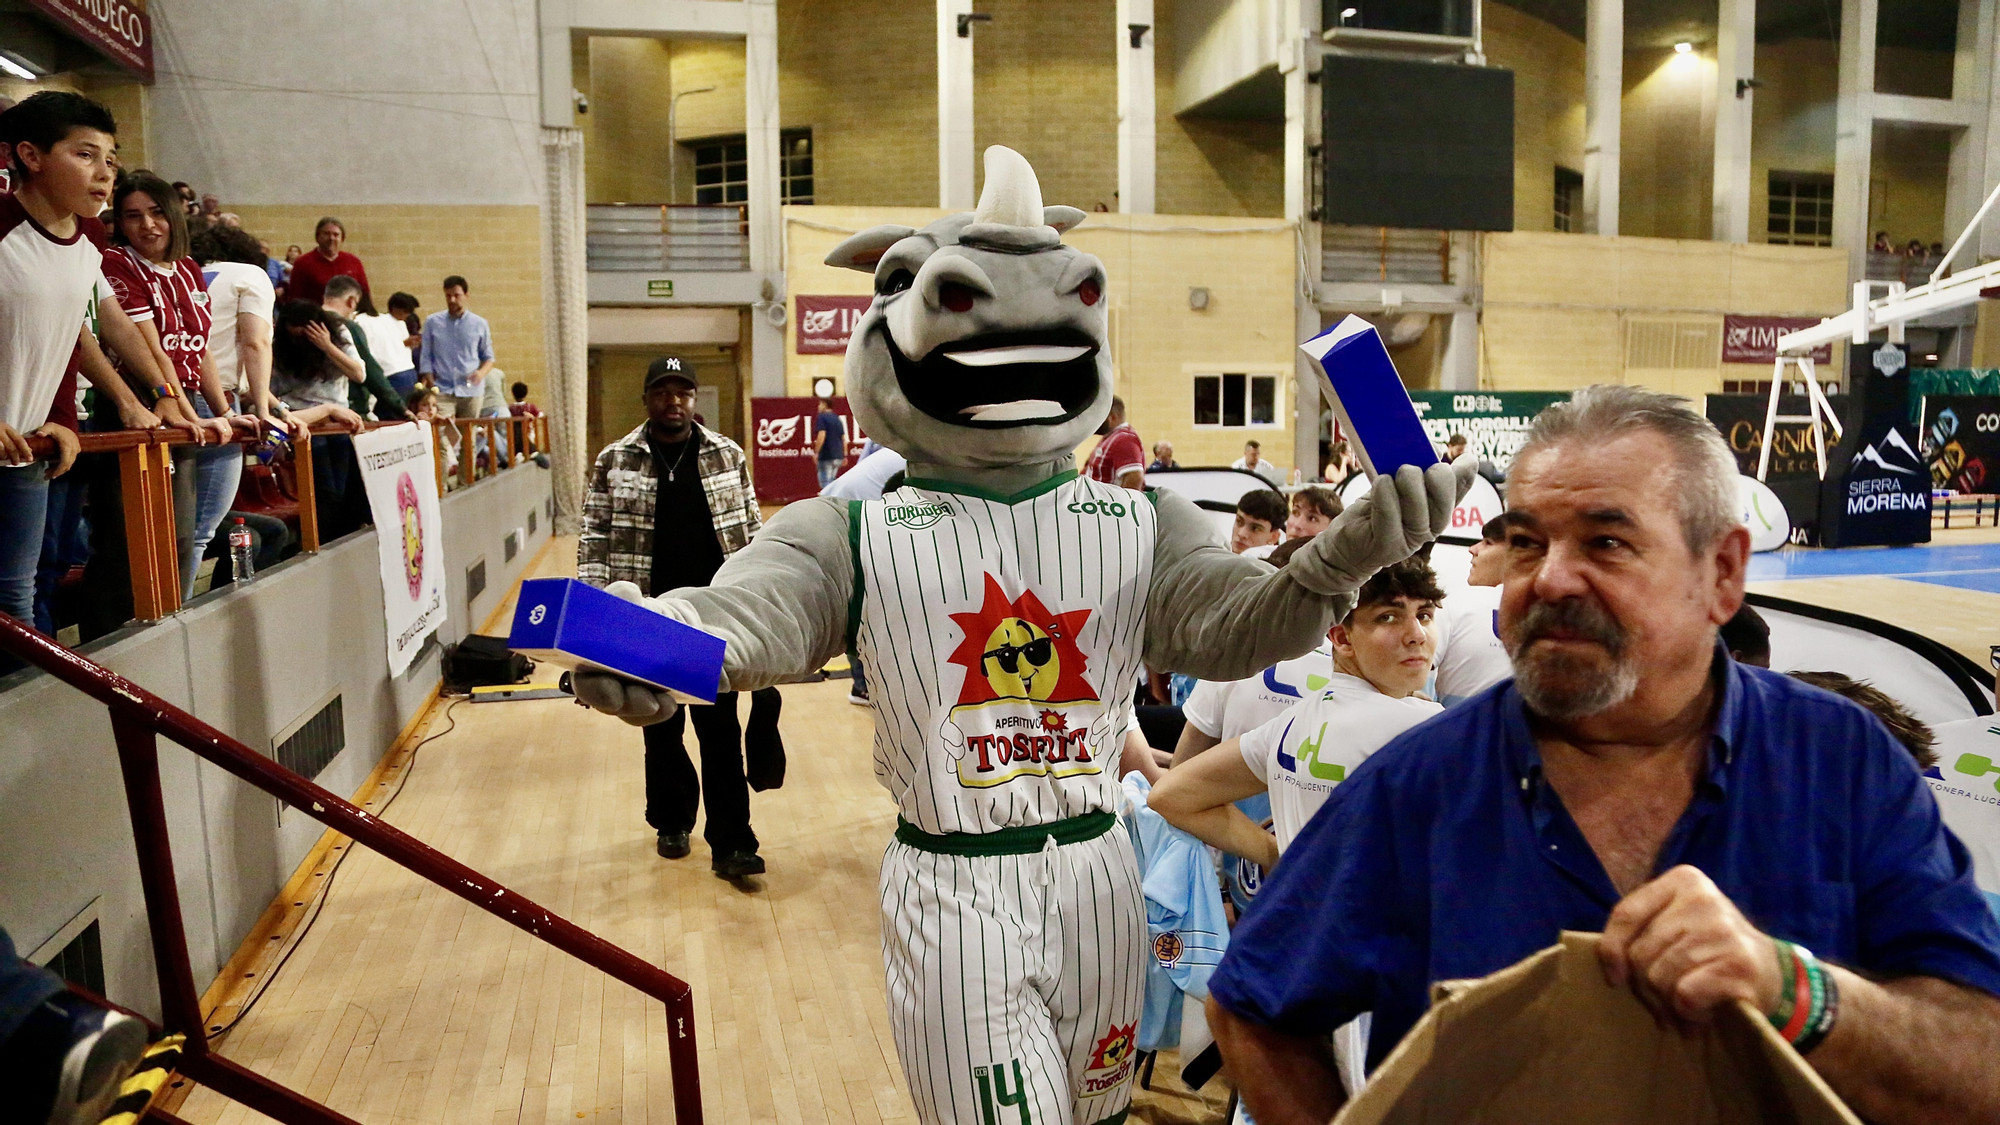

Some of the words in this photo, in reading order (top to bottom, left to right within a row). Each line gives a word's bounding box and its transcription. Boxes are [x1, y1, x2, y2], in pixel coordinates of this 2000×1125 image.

[666, 358, 681, 370] NY
[758, 448, 799, 457] Instituto
[1848, 477, 1901, 497] SIERRA
[1067, 499, 1126, 517] coto
[1847, 492, 1926, 515] MORENA
[995, 716, 1042, 730] APERITIVO
[967, 728, 1092, 772] TOSFRIT
[974, 1058, 1032, 1125] 14
